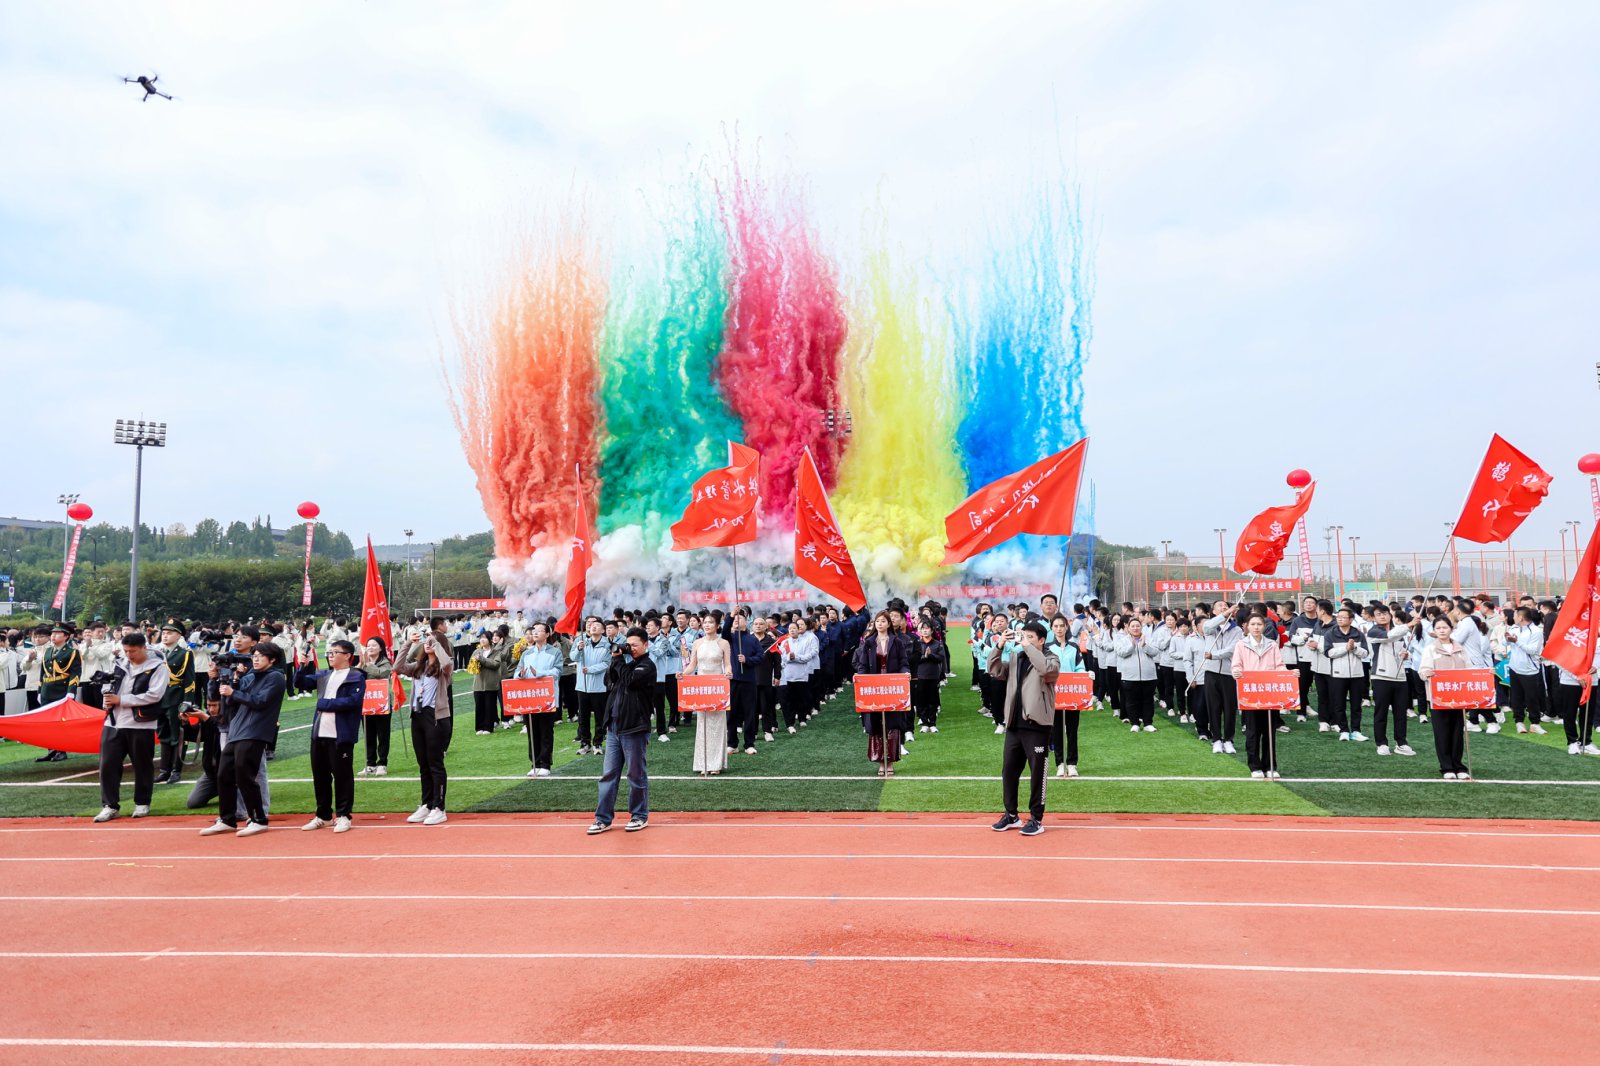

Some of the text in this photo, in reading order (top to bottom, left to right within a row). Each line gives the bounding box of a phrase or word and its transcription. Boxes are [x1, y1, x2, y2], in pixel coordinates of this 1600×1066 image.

[1243, 682, 1293, 692] 泓泉公司代表队
[1436, 681, 1489, 692] 鹊华水厂代表队
[364, 690, 384, 699] 代表队
